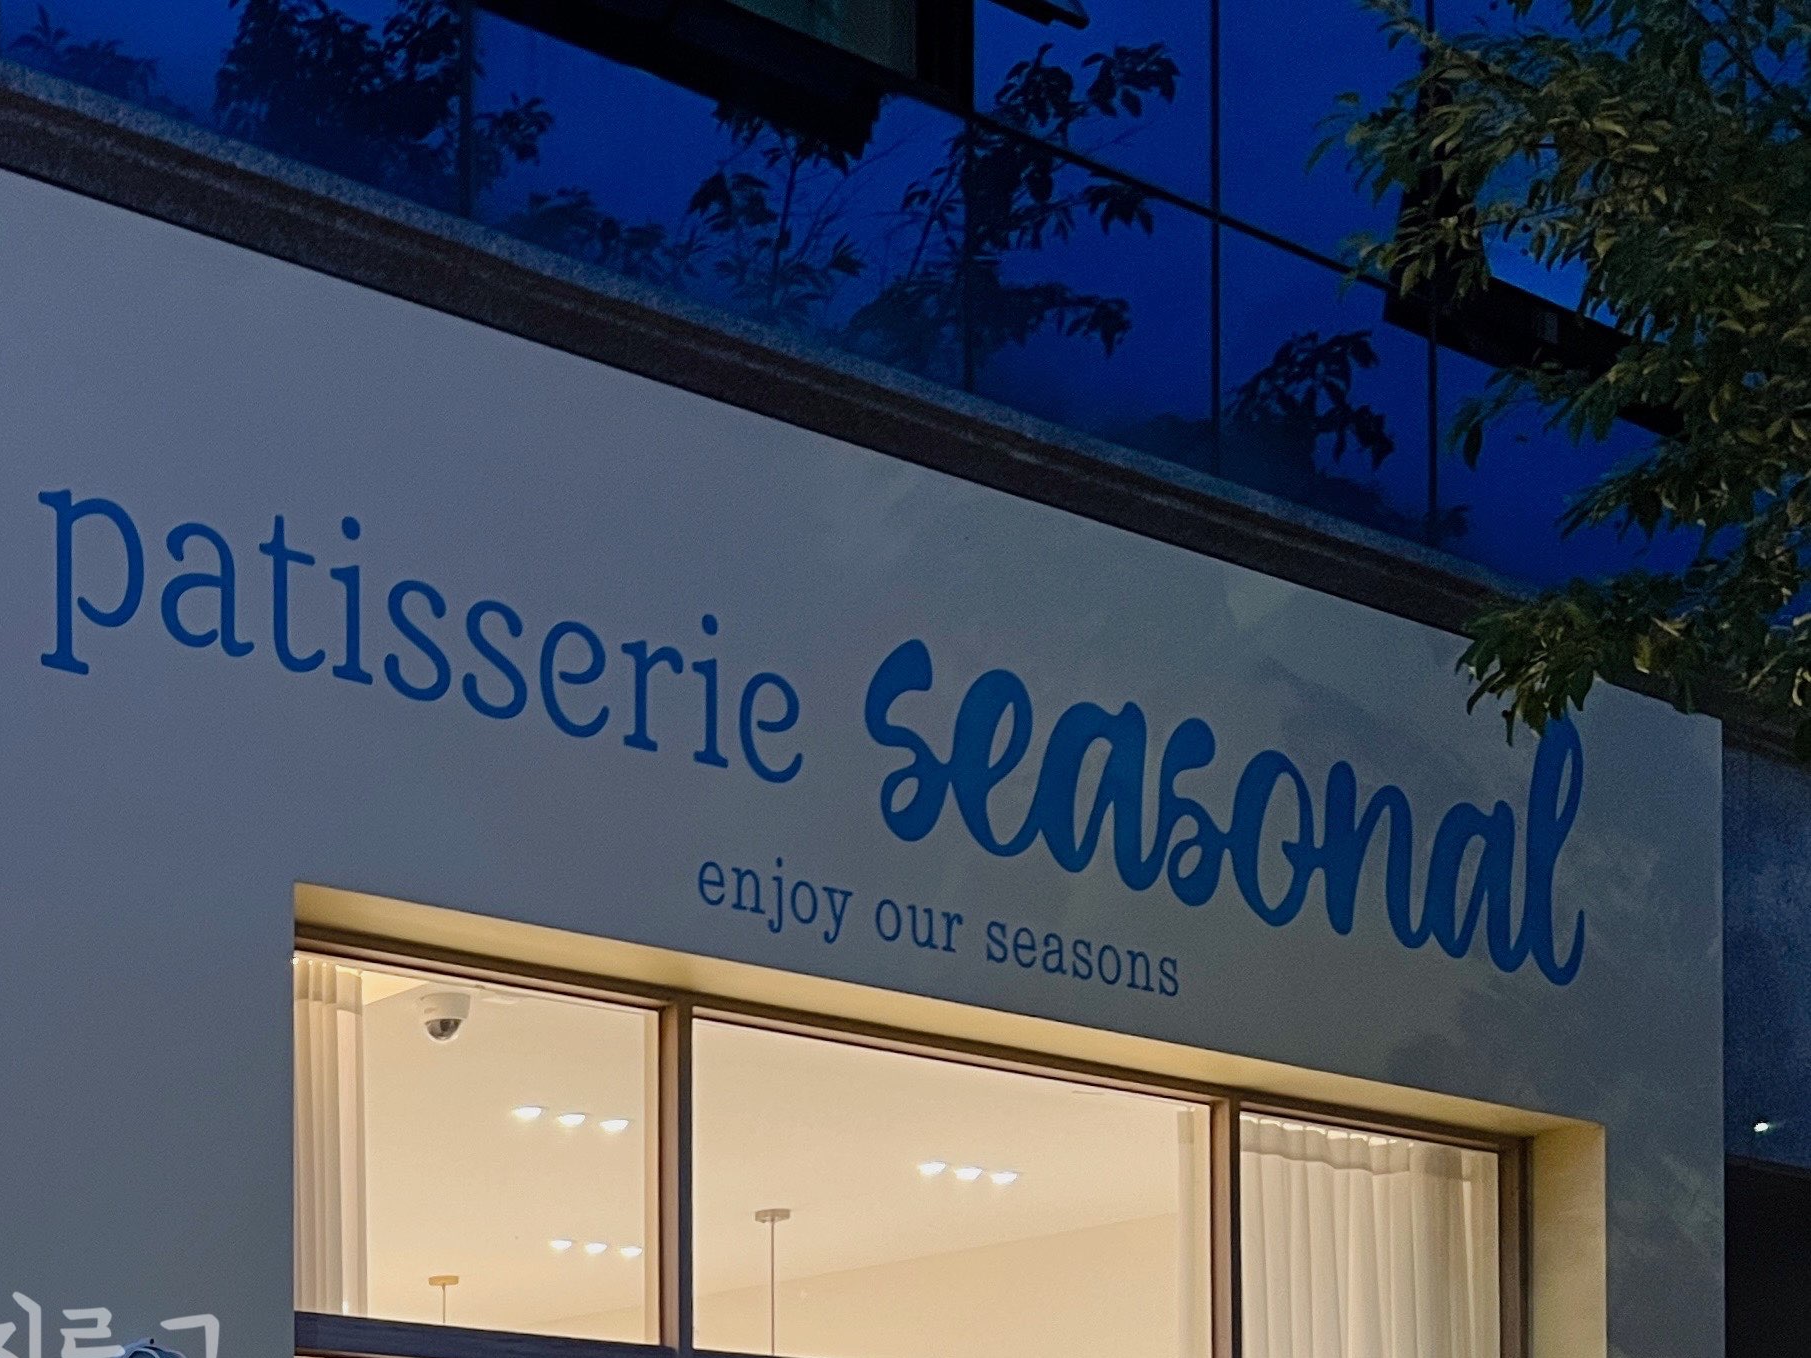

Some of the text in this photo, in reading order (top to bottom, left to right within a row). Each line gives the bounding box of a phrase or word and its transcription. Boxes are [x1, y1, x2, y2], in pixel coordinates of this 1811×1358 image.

[37, 488, 1585, 987] patisserie seasonal
[697, 856, 1179, 998] enjoy our seasons
